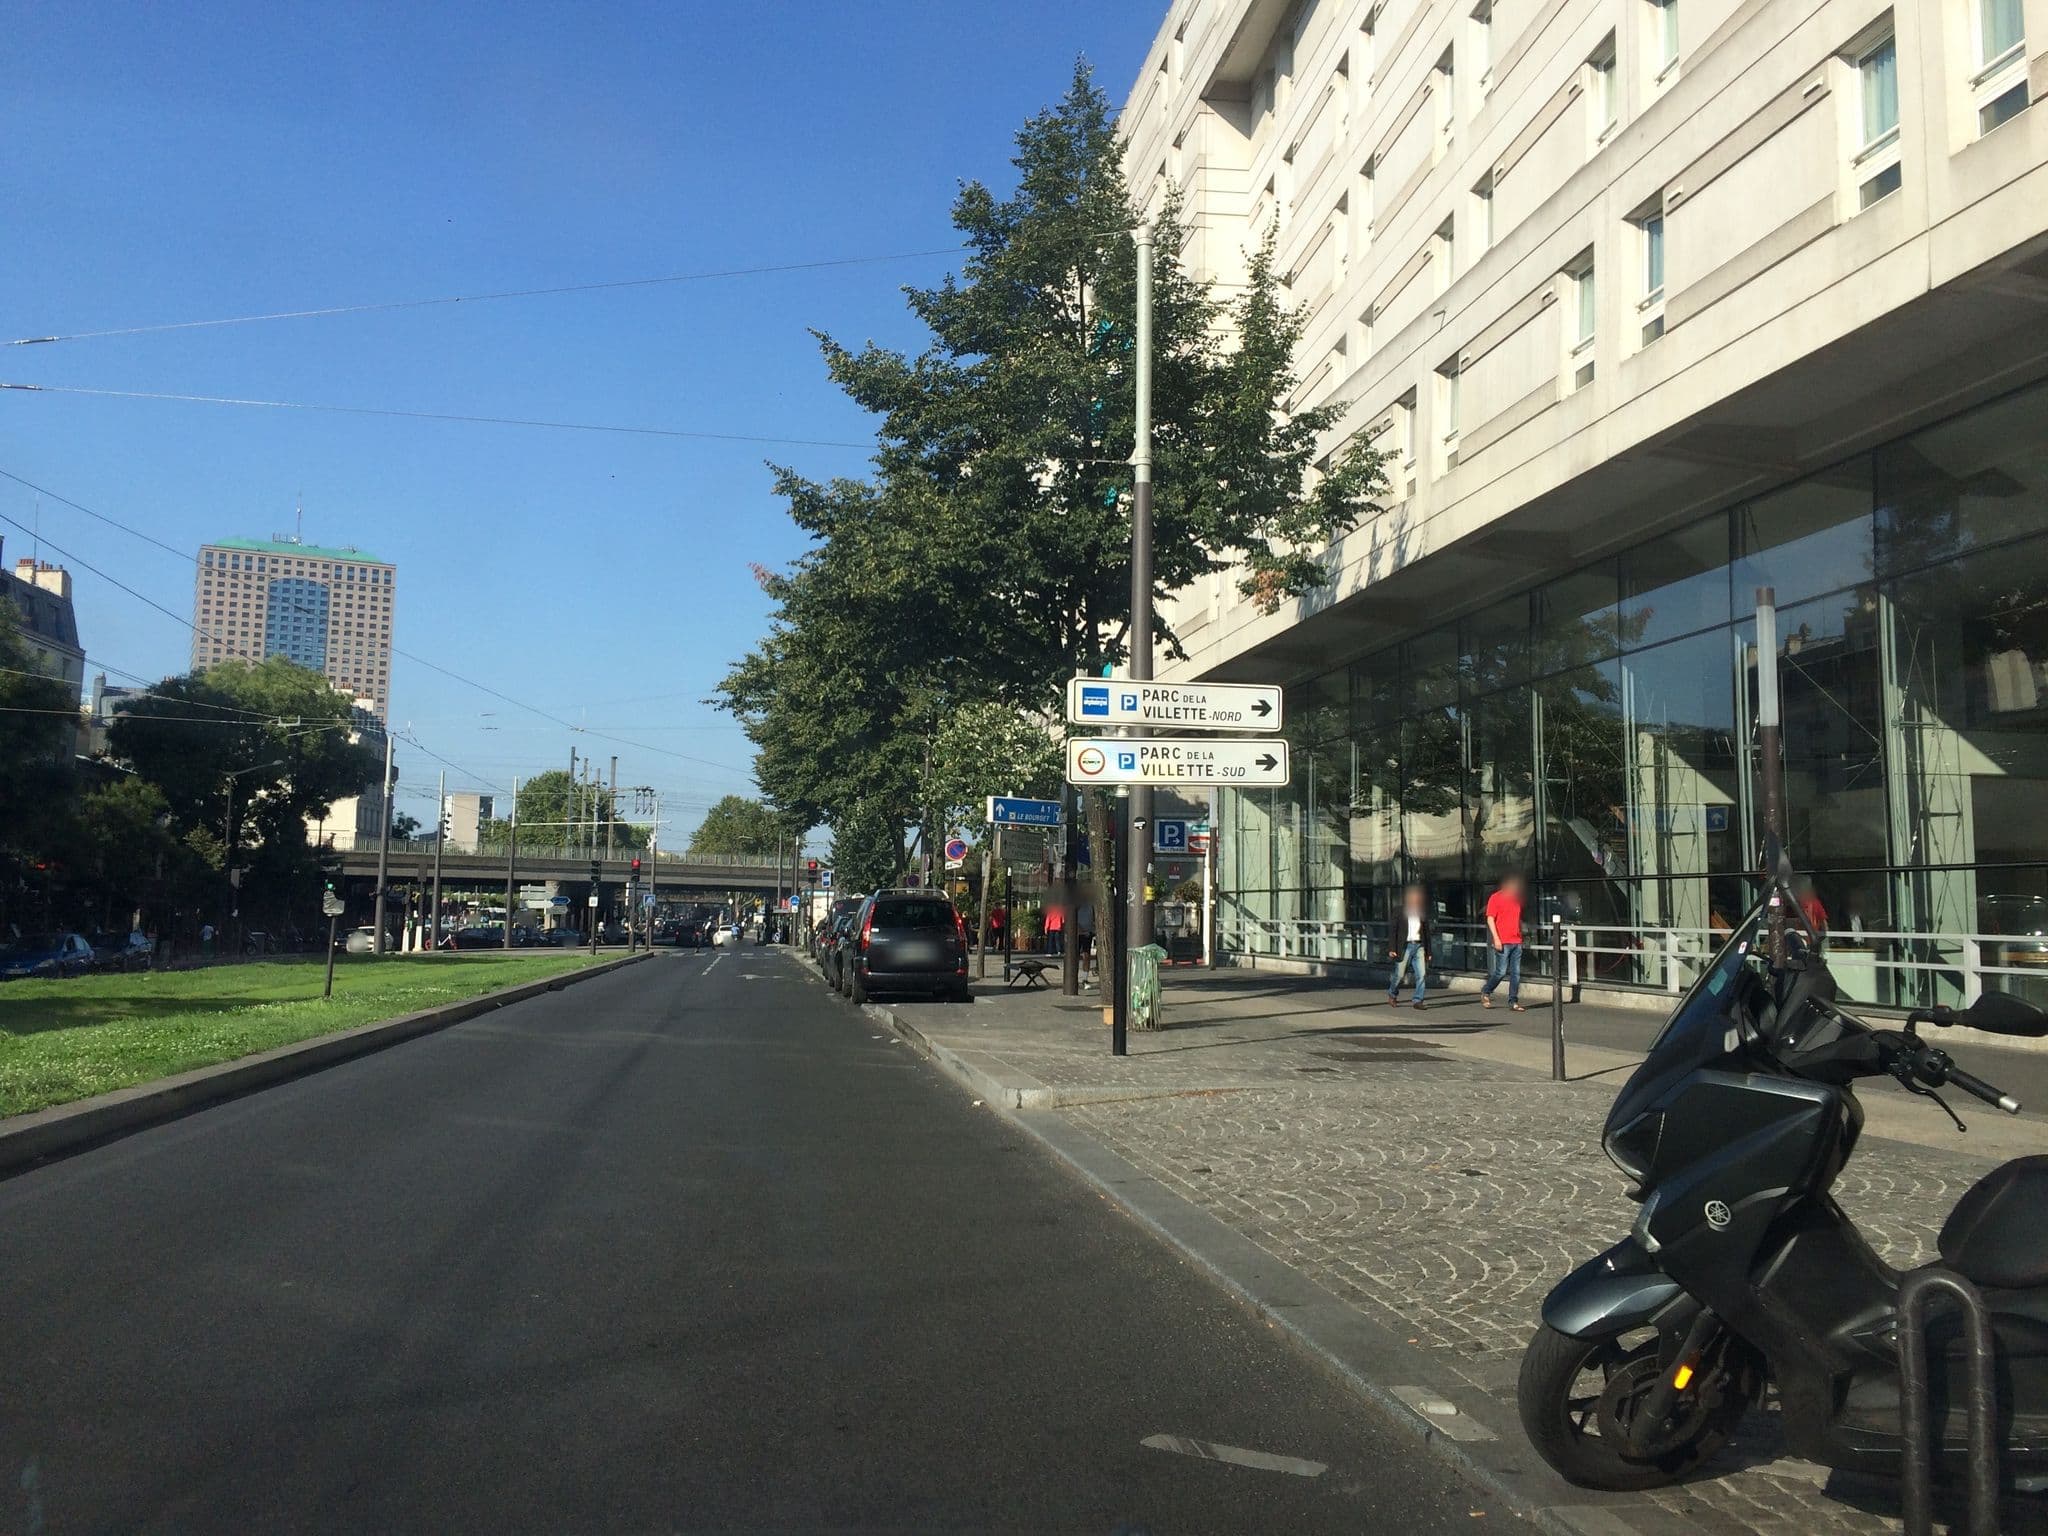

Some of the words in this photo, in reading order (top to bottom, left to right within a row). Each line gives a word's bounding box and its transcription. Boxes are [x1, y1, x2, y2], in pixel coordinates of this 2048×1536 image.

[1123, 696, 1135, 710] P
[1142, 689, 1180, 704] PARC
[1183, 695, 1194, 703] DE
[1196, 695, 1207, 704] LA
[1140, 747, 1181, 760] PARC
[1187, 751, 1200, 760] DE
[1202, 751, 1214, 760] LA
[1120, 754, 1133, 768] P
[1164, 824, 1179, 844] P
